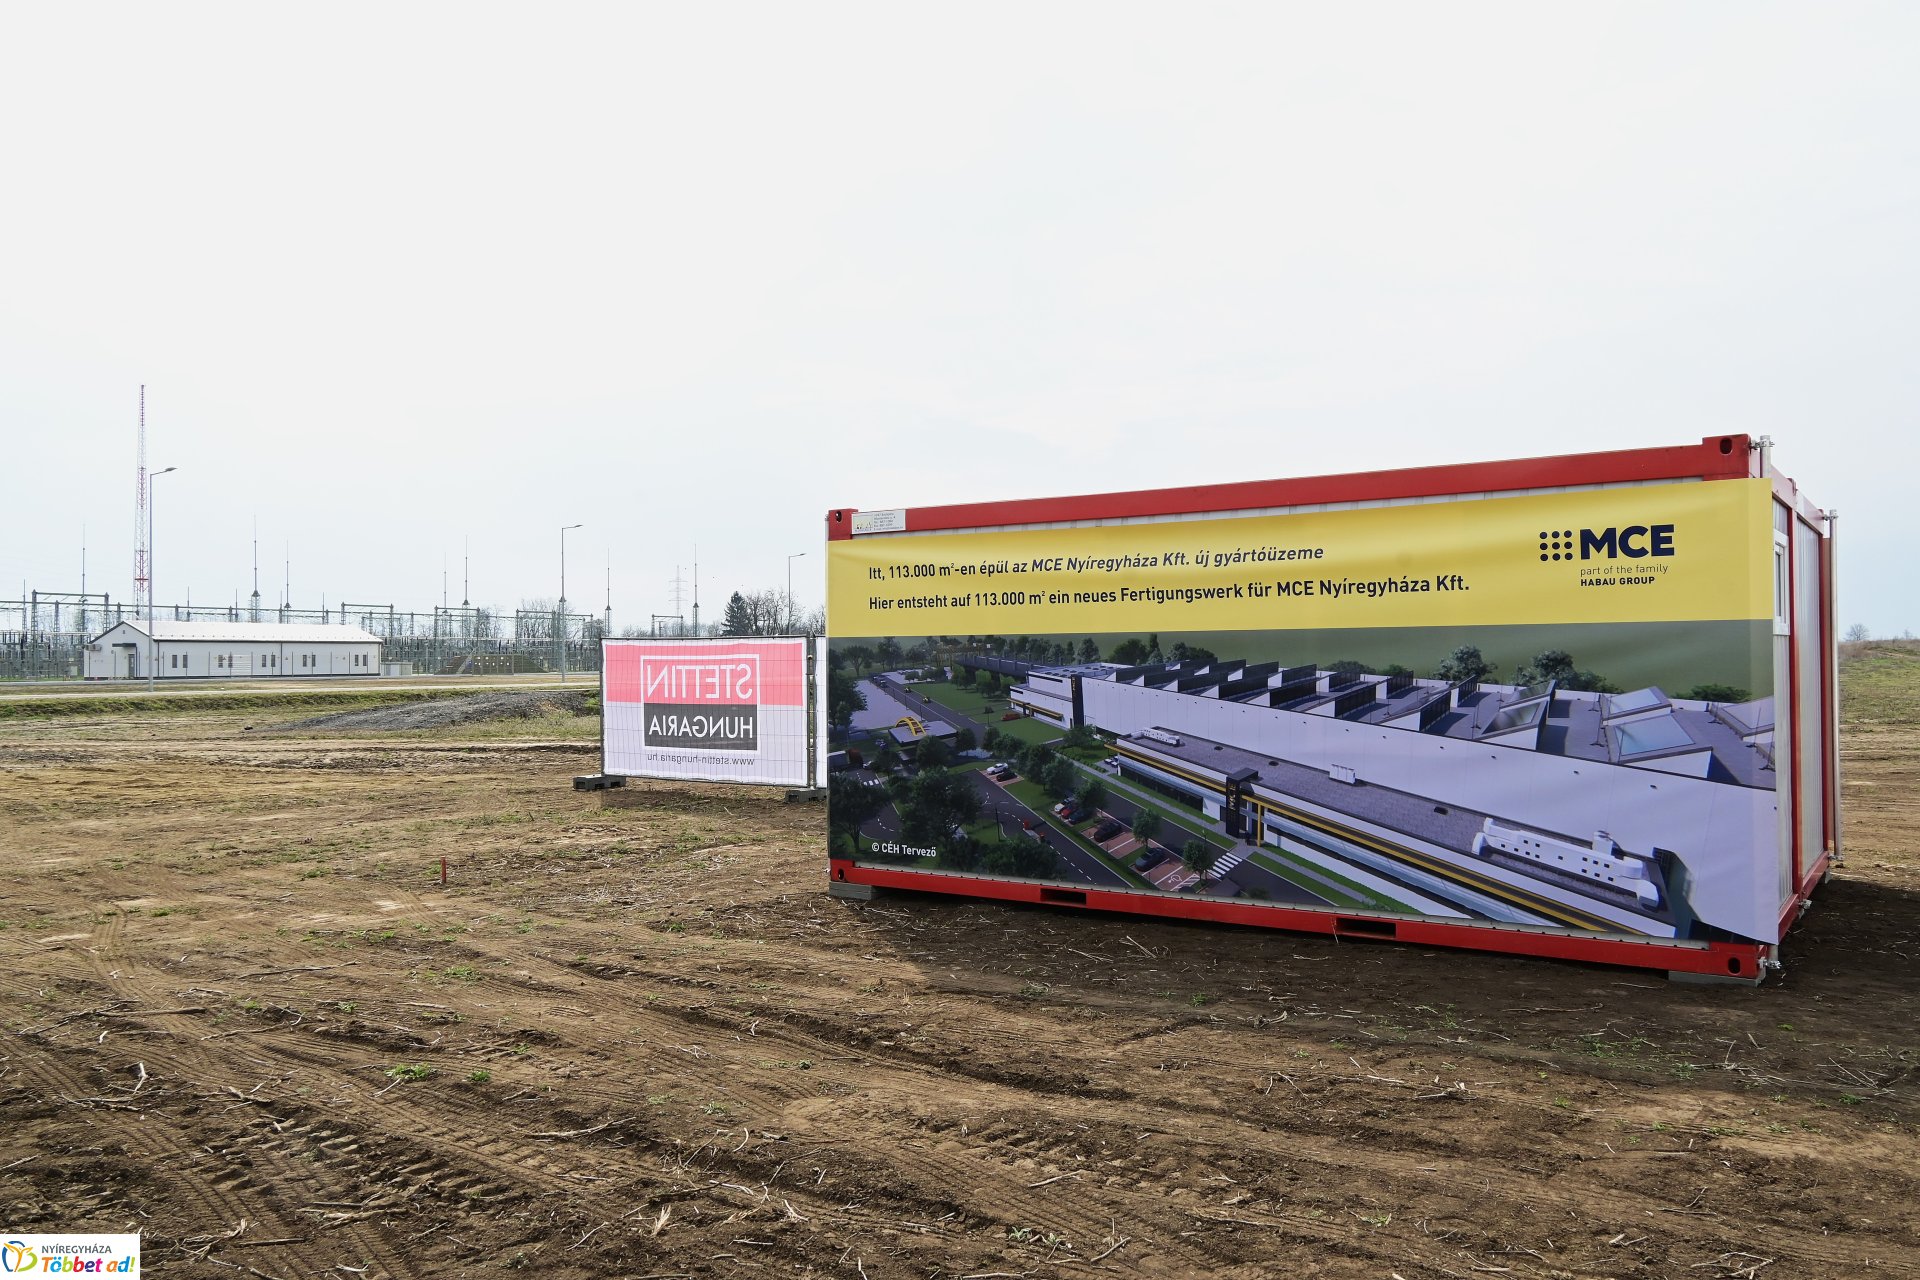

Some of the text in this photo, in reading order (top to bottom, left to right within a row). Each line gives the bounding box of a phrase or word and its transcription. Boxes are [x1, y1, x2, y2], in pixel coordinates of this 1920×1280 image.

[1580, 524, 1675, 560] MCE
[868, 566, 886, 581] Itt,
[889, 563, 936, 578] 113.000
[979, 558, 1009, 577] épül
[1012, 560, 1028, 573] az
[1031, 557, 1063, 573] MCE
[1066, 552, 1158, 572] Nyíregyháza
[1162, 552, 1190, 566] Kft.
[1195, 550, 1209, 566] új
[1213, 546, 1324, 567] gyártóüzeme
[1580, 563, 1669, 577] part of the family
[869, 596, 894, 610] Hier
[897, 594, 948, 608] entsteht
[951, 593, 971, 607] auf
[975, 592, 1026, 606] 113.000
[1048, 590, 1070, 604] ein
[1073, 590, 1117, 603] neues
[1120, 584, 1243, 604] Fertigungswerk
[1247, 581, 1272, 598] für
[1277, 581, 1315, 597] MCE
[1319, 575, 1431, 599] Nyíregyháza
[1436, 574, 1470, 592] Kft.
[1580, 576, 1656, 587] HABAU GROUP
[881, 841, 900, 854] CÉH
[901, 844, 937, 857] Tervező
